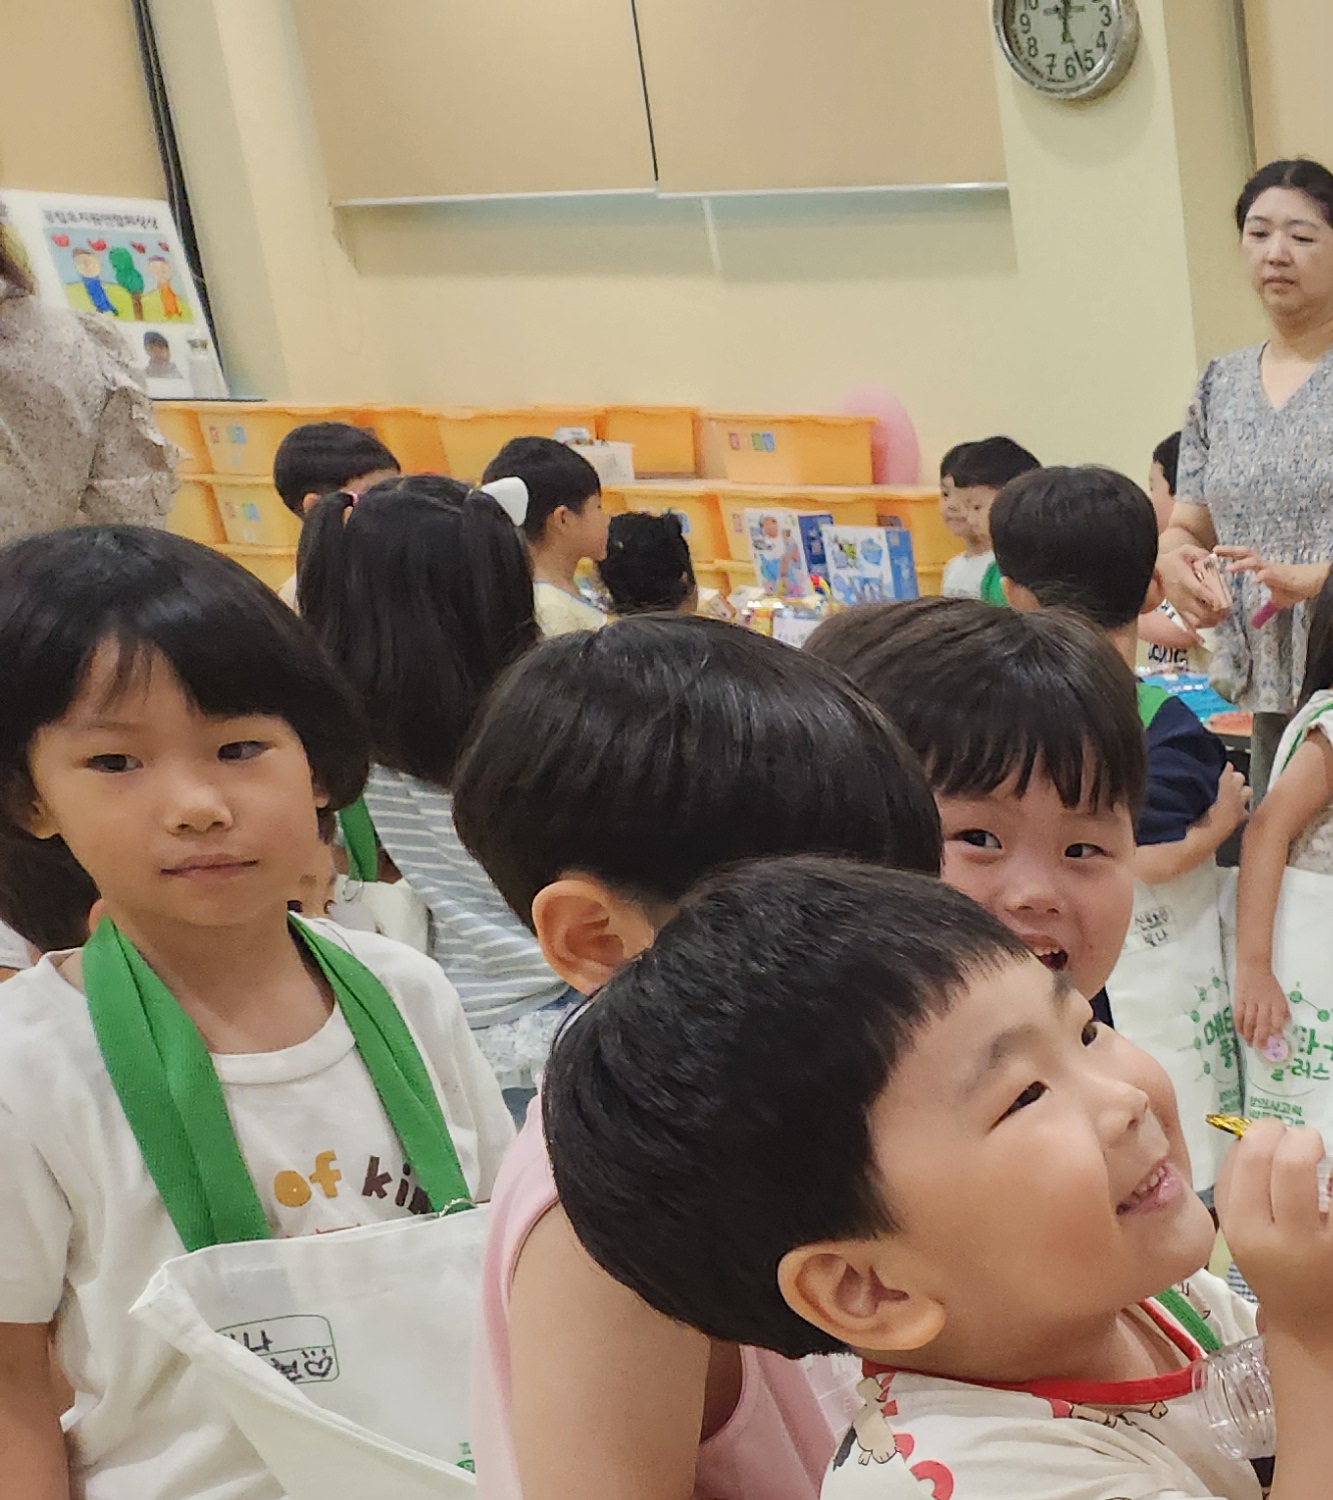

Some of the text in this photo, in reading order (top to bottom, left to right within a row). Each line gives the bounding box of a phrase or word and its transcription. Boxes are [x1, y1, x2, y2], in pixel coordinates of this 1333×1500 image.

[1019, 13, 1031, 34] 9
[1099, 5, 1112, 26] 3
[1026, 36, 1038, 58] 8
[1096, 31, 1107, 51] 4
[1044, 54, 1057, 75] 7
[1064, 56, 1077, 79] 6
[1083, 49, 1095, 72] 5
[273, 1149, 343, 1208] of
